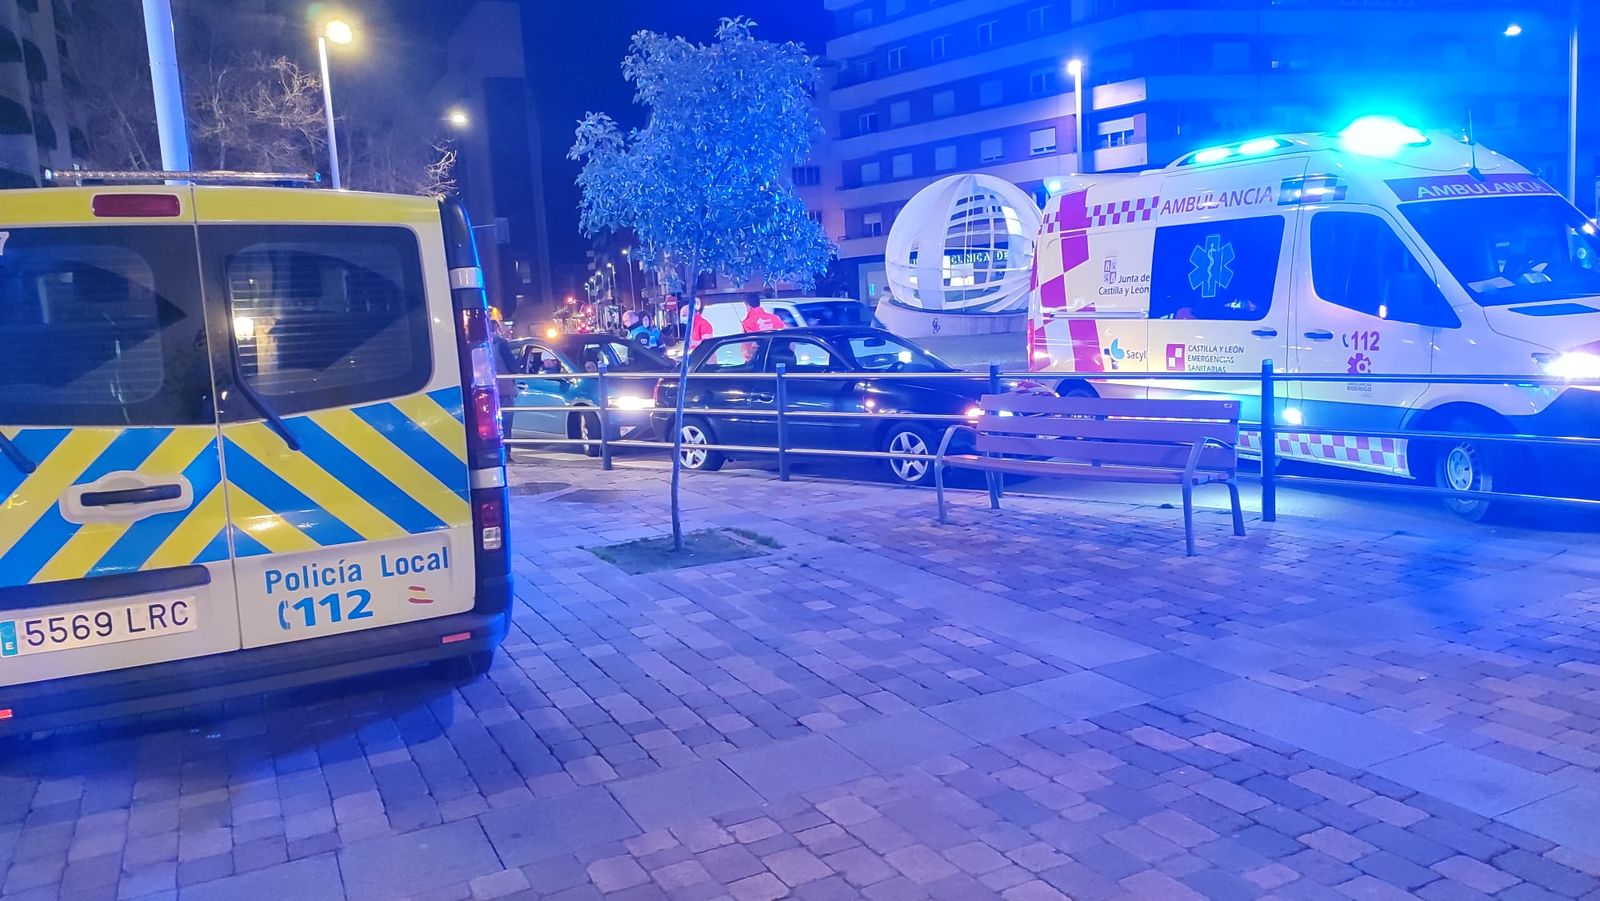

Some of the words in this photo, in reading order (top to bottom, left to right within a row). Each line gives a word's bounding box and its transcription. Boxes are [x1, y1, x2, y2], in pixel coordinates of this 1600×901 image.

[1417, 181, 1548, 198] AMBULANCIA
[1160, 186, 1273, 215] AMBULANCIA
[1118, 275, 1139, 283] Junta
[1140, 273, 1151, 282] de
[1098, 286, 1123, 295] Castilla
[1124, 288, 1130, 297] y
[1131, 285, 1149, 294] León
[1351, 331, 1380, 350] 112
[1126, 350, 1146, 361] Sacyl
[1225, 345, 1244, 353] LEÓN
[1188, 355, 1234, 363] EMERGENCIAS
[265, 558, 362, 594] Policía
[380, 546, 449, 578] Local
[292, 588, 374, 627] 112
[25, 611, 114, 647] 5569
[127, 600, 189, 634] LRC
[5, 641, 14, 650] E
